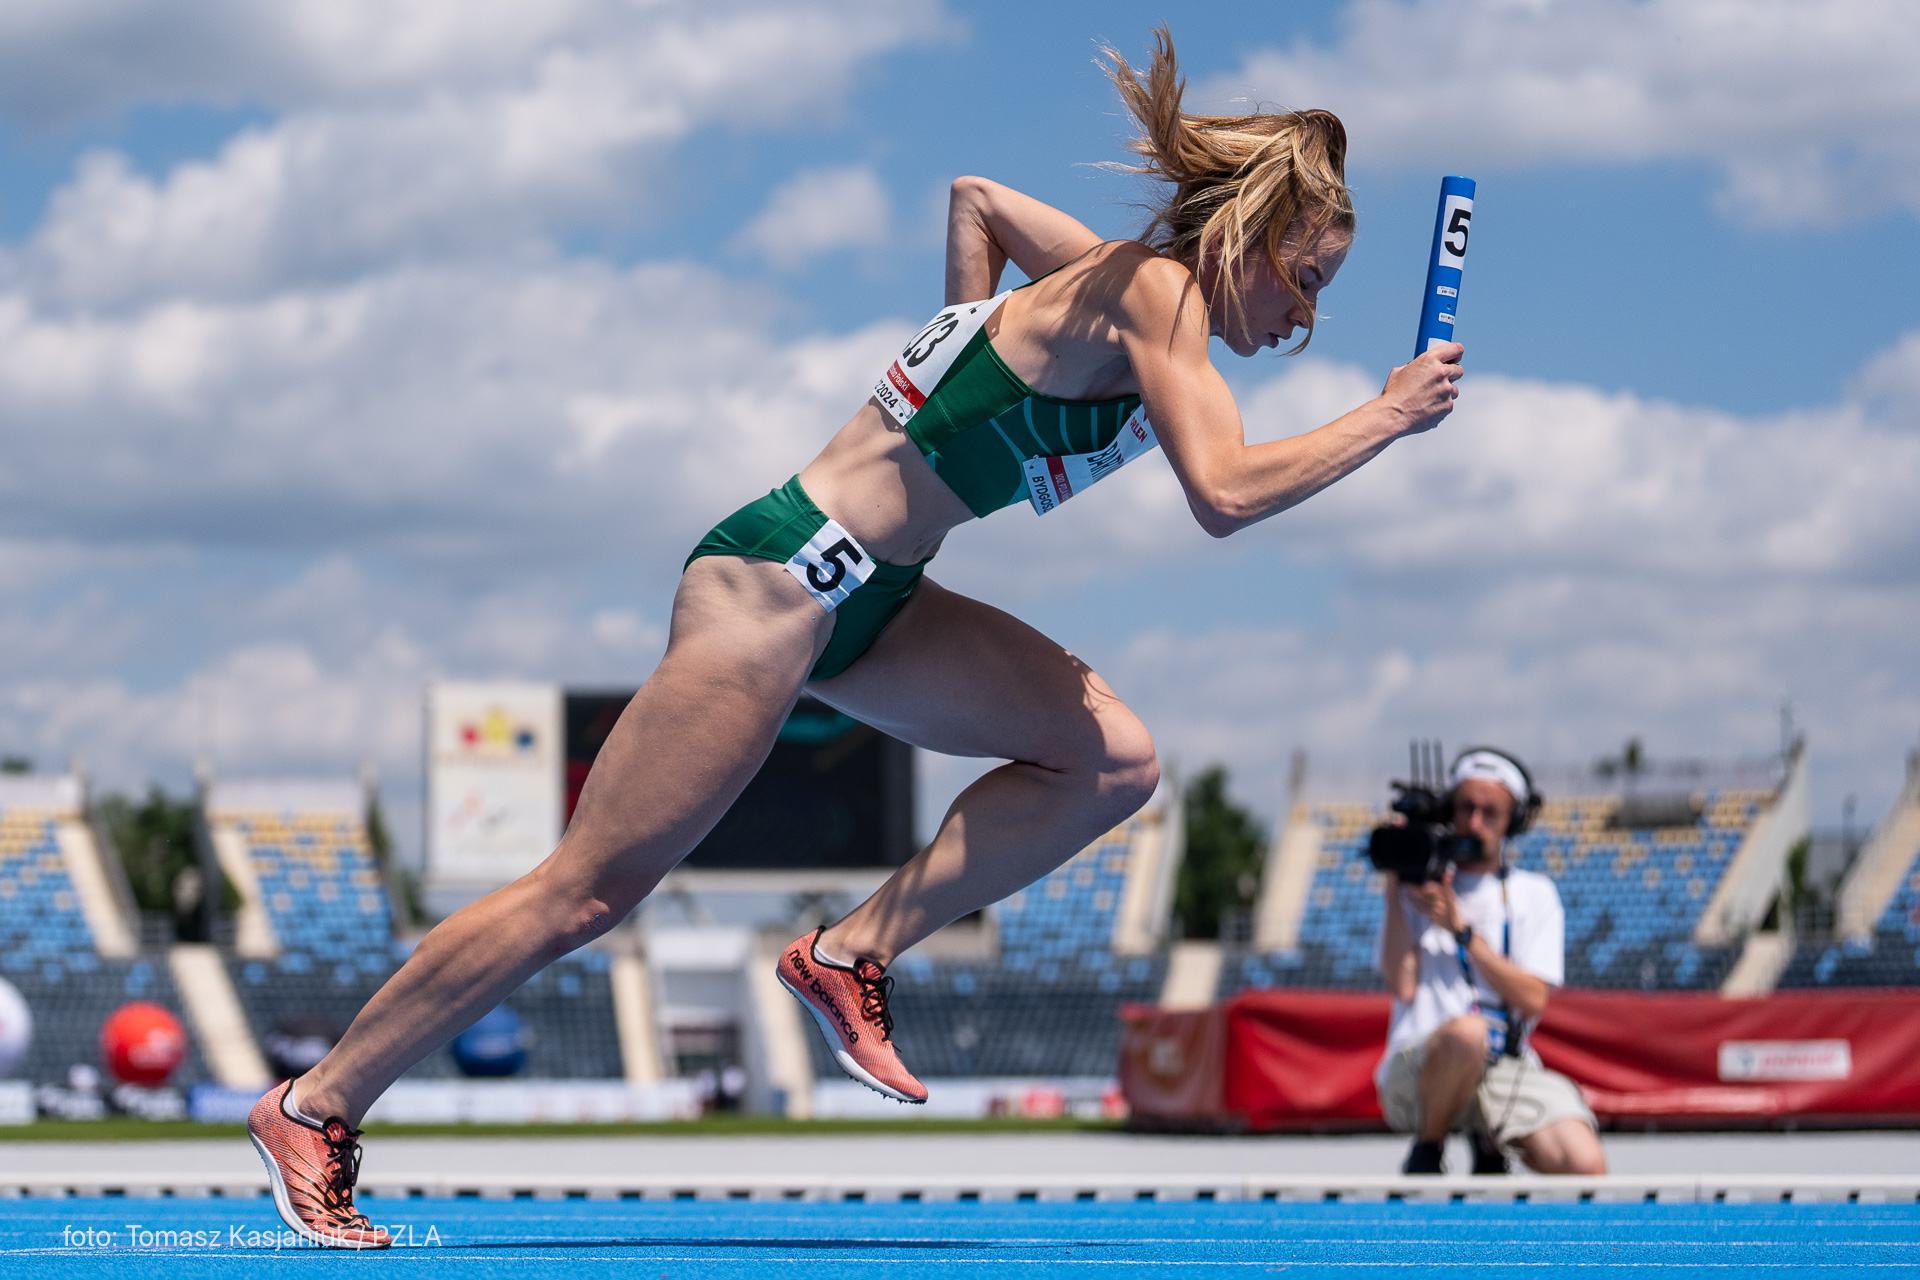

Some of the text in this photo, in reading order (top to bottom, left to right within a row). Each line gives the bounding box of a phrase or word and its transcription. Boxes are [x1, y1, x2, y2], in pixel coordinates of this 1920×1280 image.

[1444, 208, 1472, 258] 5
[876, 383, 899, 409] 2024
[807, 537, 863, 592] 5
[788, 949, 859, 1044] new balance
